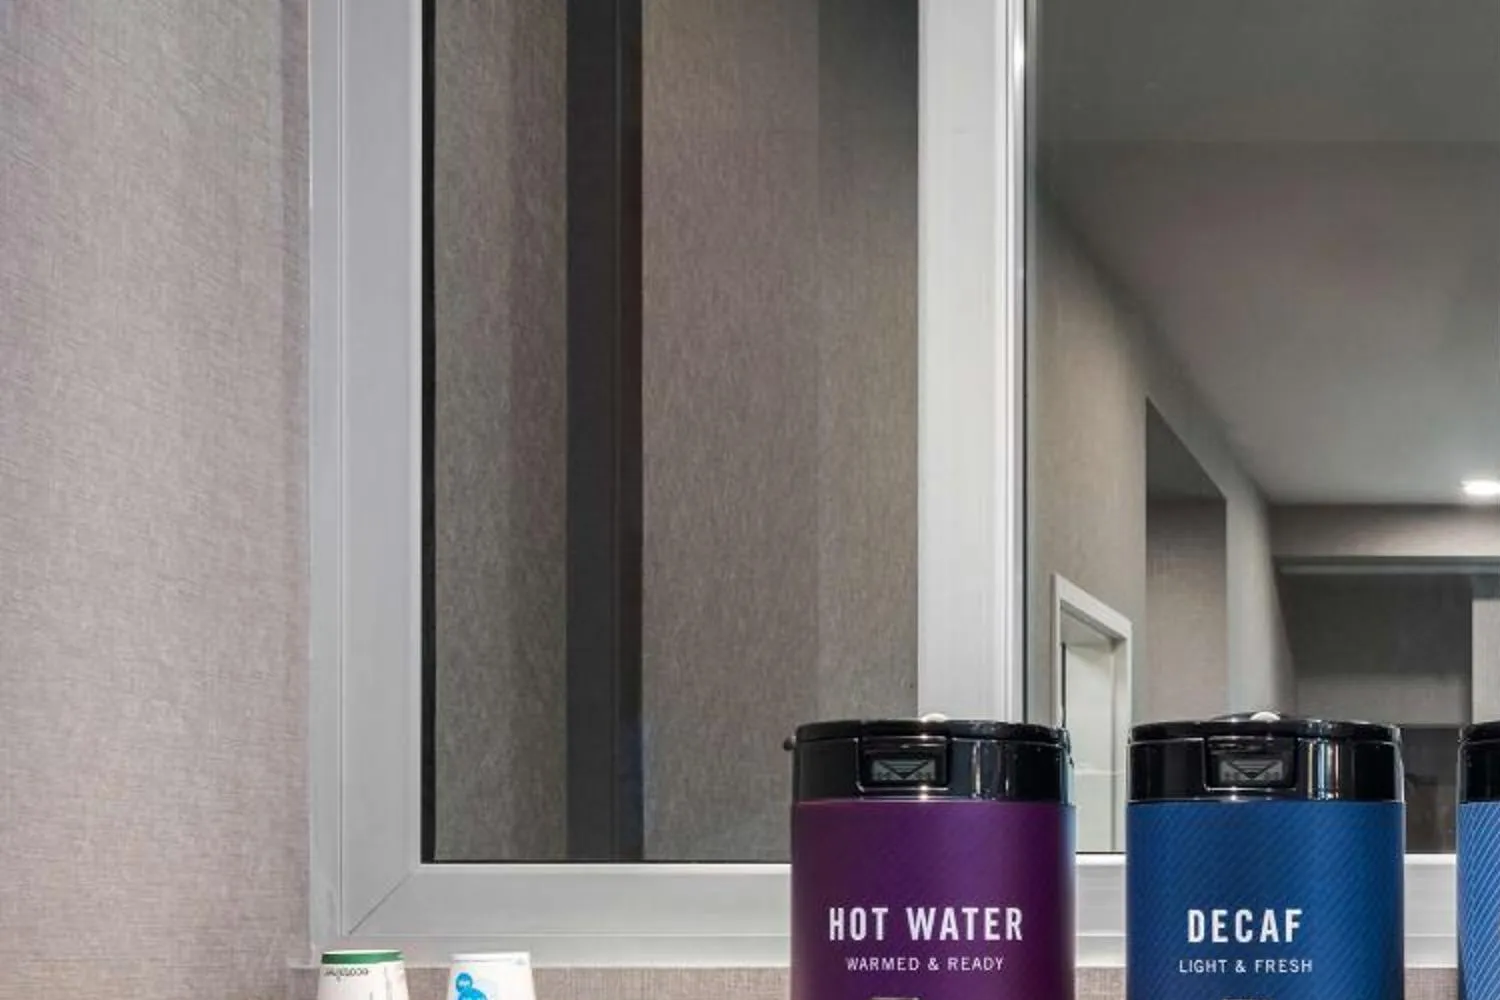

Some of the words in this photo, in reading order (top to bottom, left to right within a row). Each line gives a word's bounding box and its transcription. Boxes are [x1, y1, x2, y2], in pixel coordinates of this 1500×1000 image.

[829, 907, 889, 941] HOT
[906, 907, 1022, 941] WATER
[1188, 908, 1302, 943] DECAF
[846, 956, 920, 972] WARMED
[927, 956, 940, 972] &
[947, 956, 1004, 972] READY
[1179, 958, 1228, 974] LIGHT
[1235, 958, 1248, 974] &
[1254, 958, 1313, 974] FRESH
